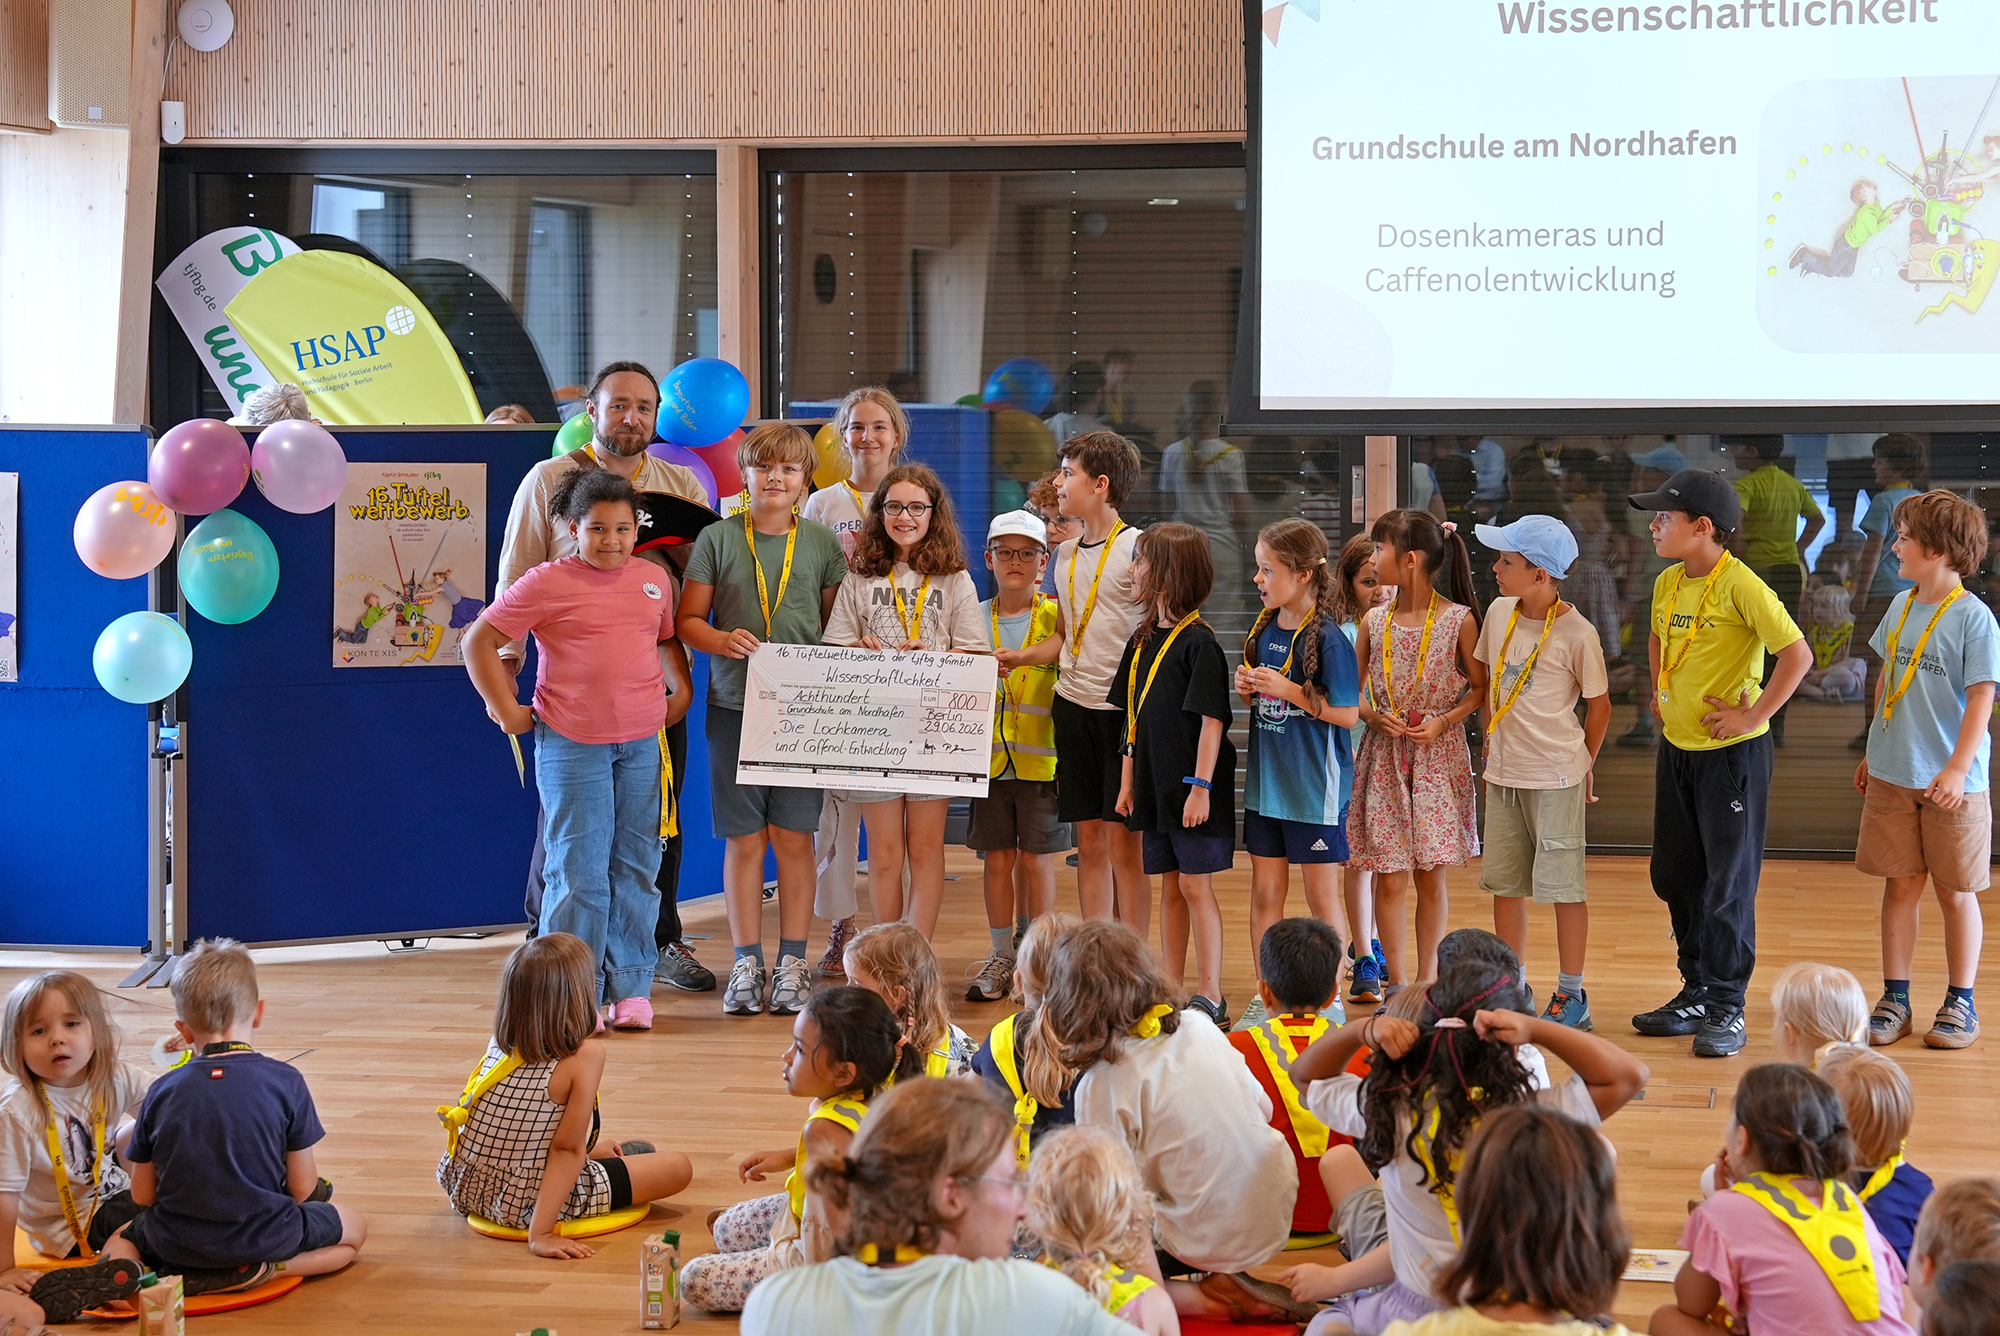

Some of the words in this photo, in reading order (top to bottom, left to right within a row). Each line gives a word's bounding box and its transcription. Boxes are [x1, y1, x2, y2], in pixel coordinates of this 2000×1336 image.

[1497, 0, 1938, 34] Wissenschaftlichkeit
[1311, 133, 1506, 162] Grundschule
[1512, 137, 1561, 159] am
[1568, 129, 1738, 159] Nordhafen
[1376, 221, 1598, 250] Dosenkameras
[1606, 219, 1666, 248] und
[183, 262, 217, 312] tjfbg.de
[1364, 264, 1677, 299] Caffenolentwicklung
[290, 325, 386, 371] HSAP
[301, 373, 338, 387] Hochschule
[338, 371, 349, 379] für
[349, 367, 371, 377] Soziale
[372, 362, 393, 372] Arbeit
[304, 387, 317, 396] und
[317, 382, 350, 393] Pädagogik
[354, 377, 374, 386] Berlin
[391, 482, 450, 507] Tüftel
[349, 499, 471, 521] wettbewerb
[776, 645, 791, 658] 16.
[891, 652, 907, 662] der
[911, 652, 935, 669] tjfbg
[936, 654, 975, 668] gGmbH
[793, 688, 870, 704] Achthundert
[948, 692, 978, 711] 800
[787, 704, 835, 716] Grundschule
[857, 705, 905, 720] Nordhafen
[922, 707, 963, 722] Berlin
[813, 718, 892, 737] Lochkamera
[923, 720, 985, 735] 29.06.2026
[775, 739, 800, 752] und
